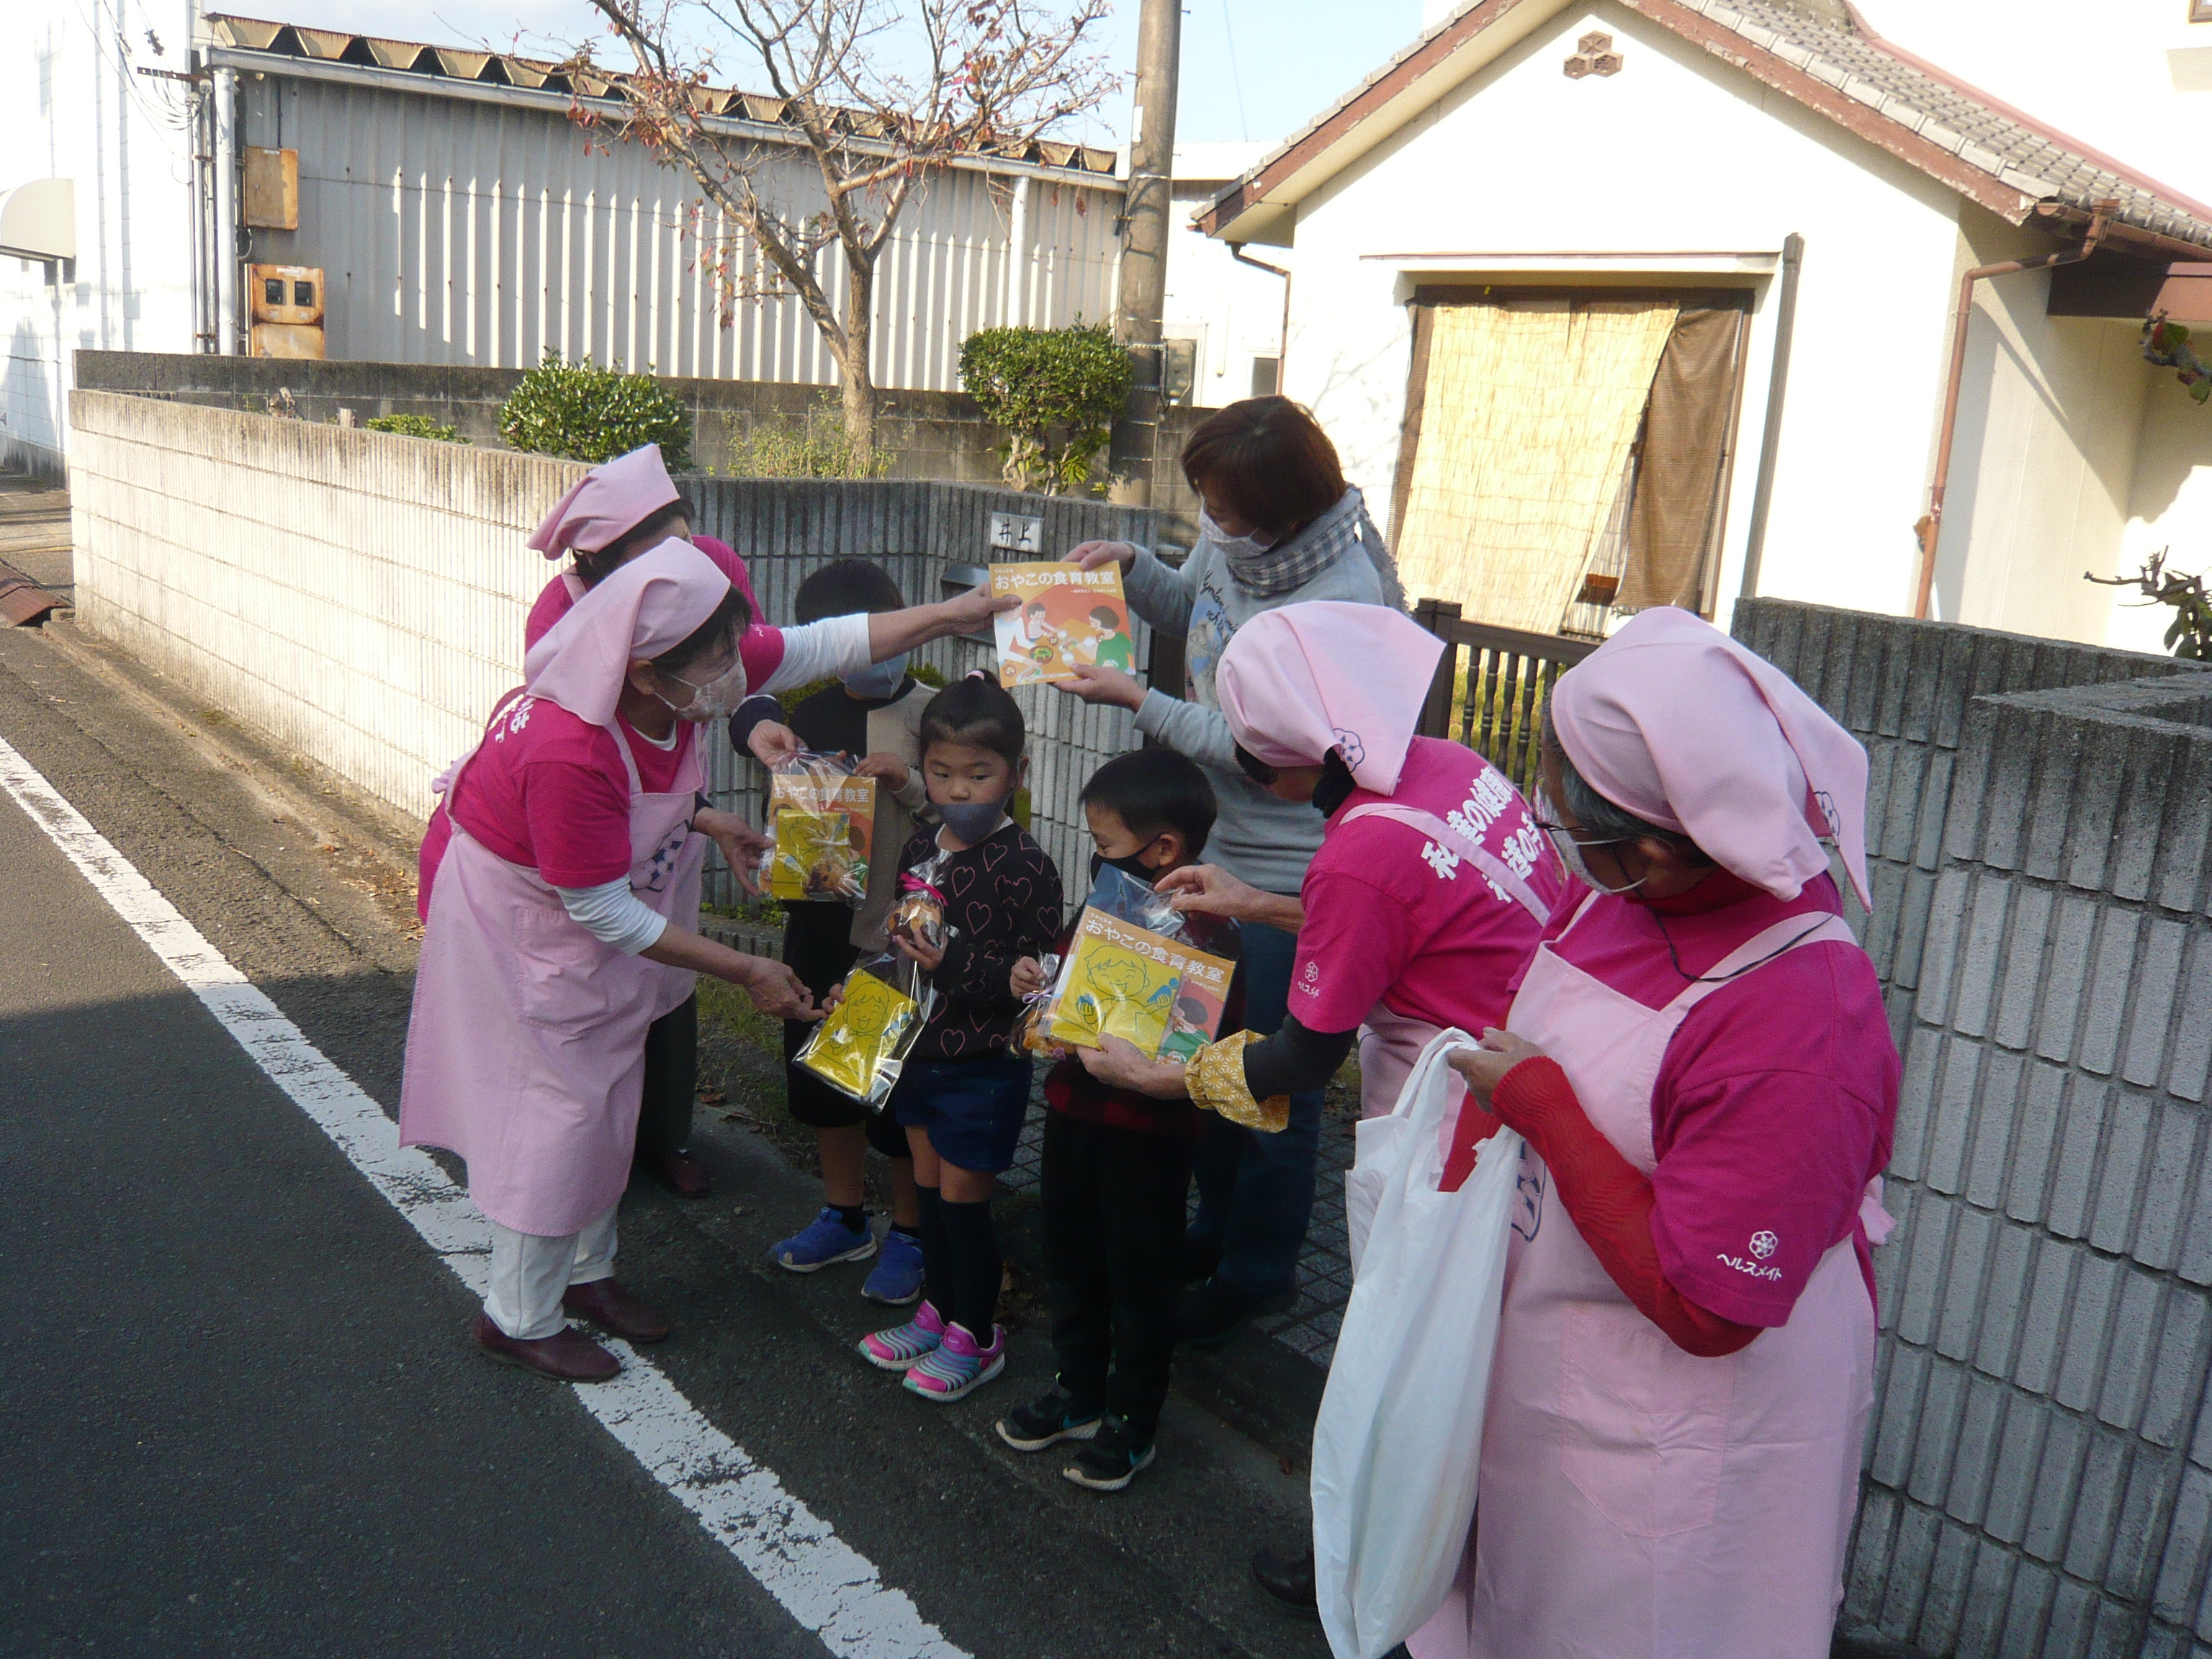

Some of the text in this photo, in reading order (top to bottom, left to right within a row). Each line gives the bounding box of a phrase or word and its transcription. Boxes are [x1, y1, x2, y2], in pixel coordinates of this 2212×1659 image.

[999, 518, 1031, 546] 井上
[995, 571, 1115, 590] おやこの食育教室
[774, 785, 870, 803] おやこの食育教室
[1085, 919, 1224, 984] おやこの食育教室
[1716, 1253, 1783, 1282] ヘルスメイト
